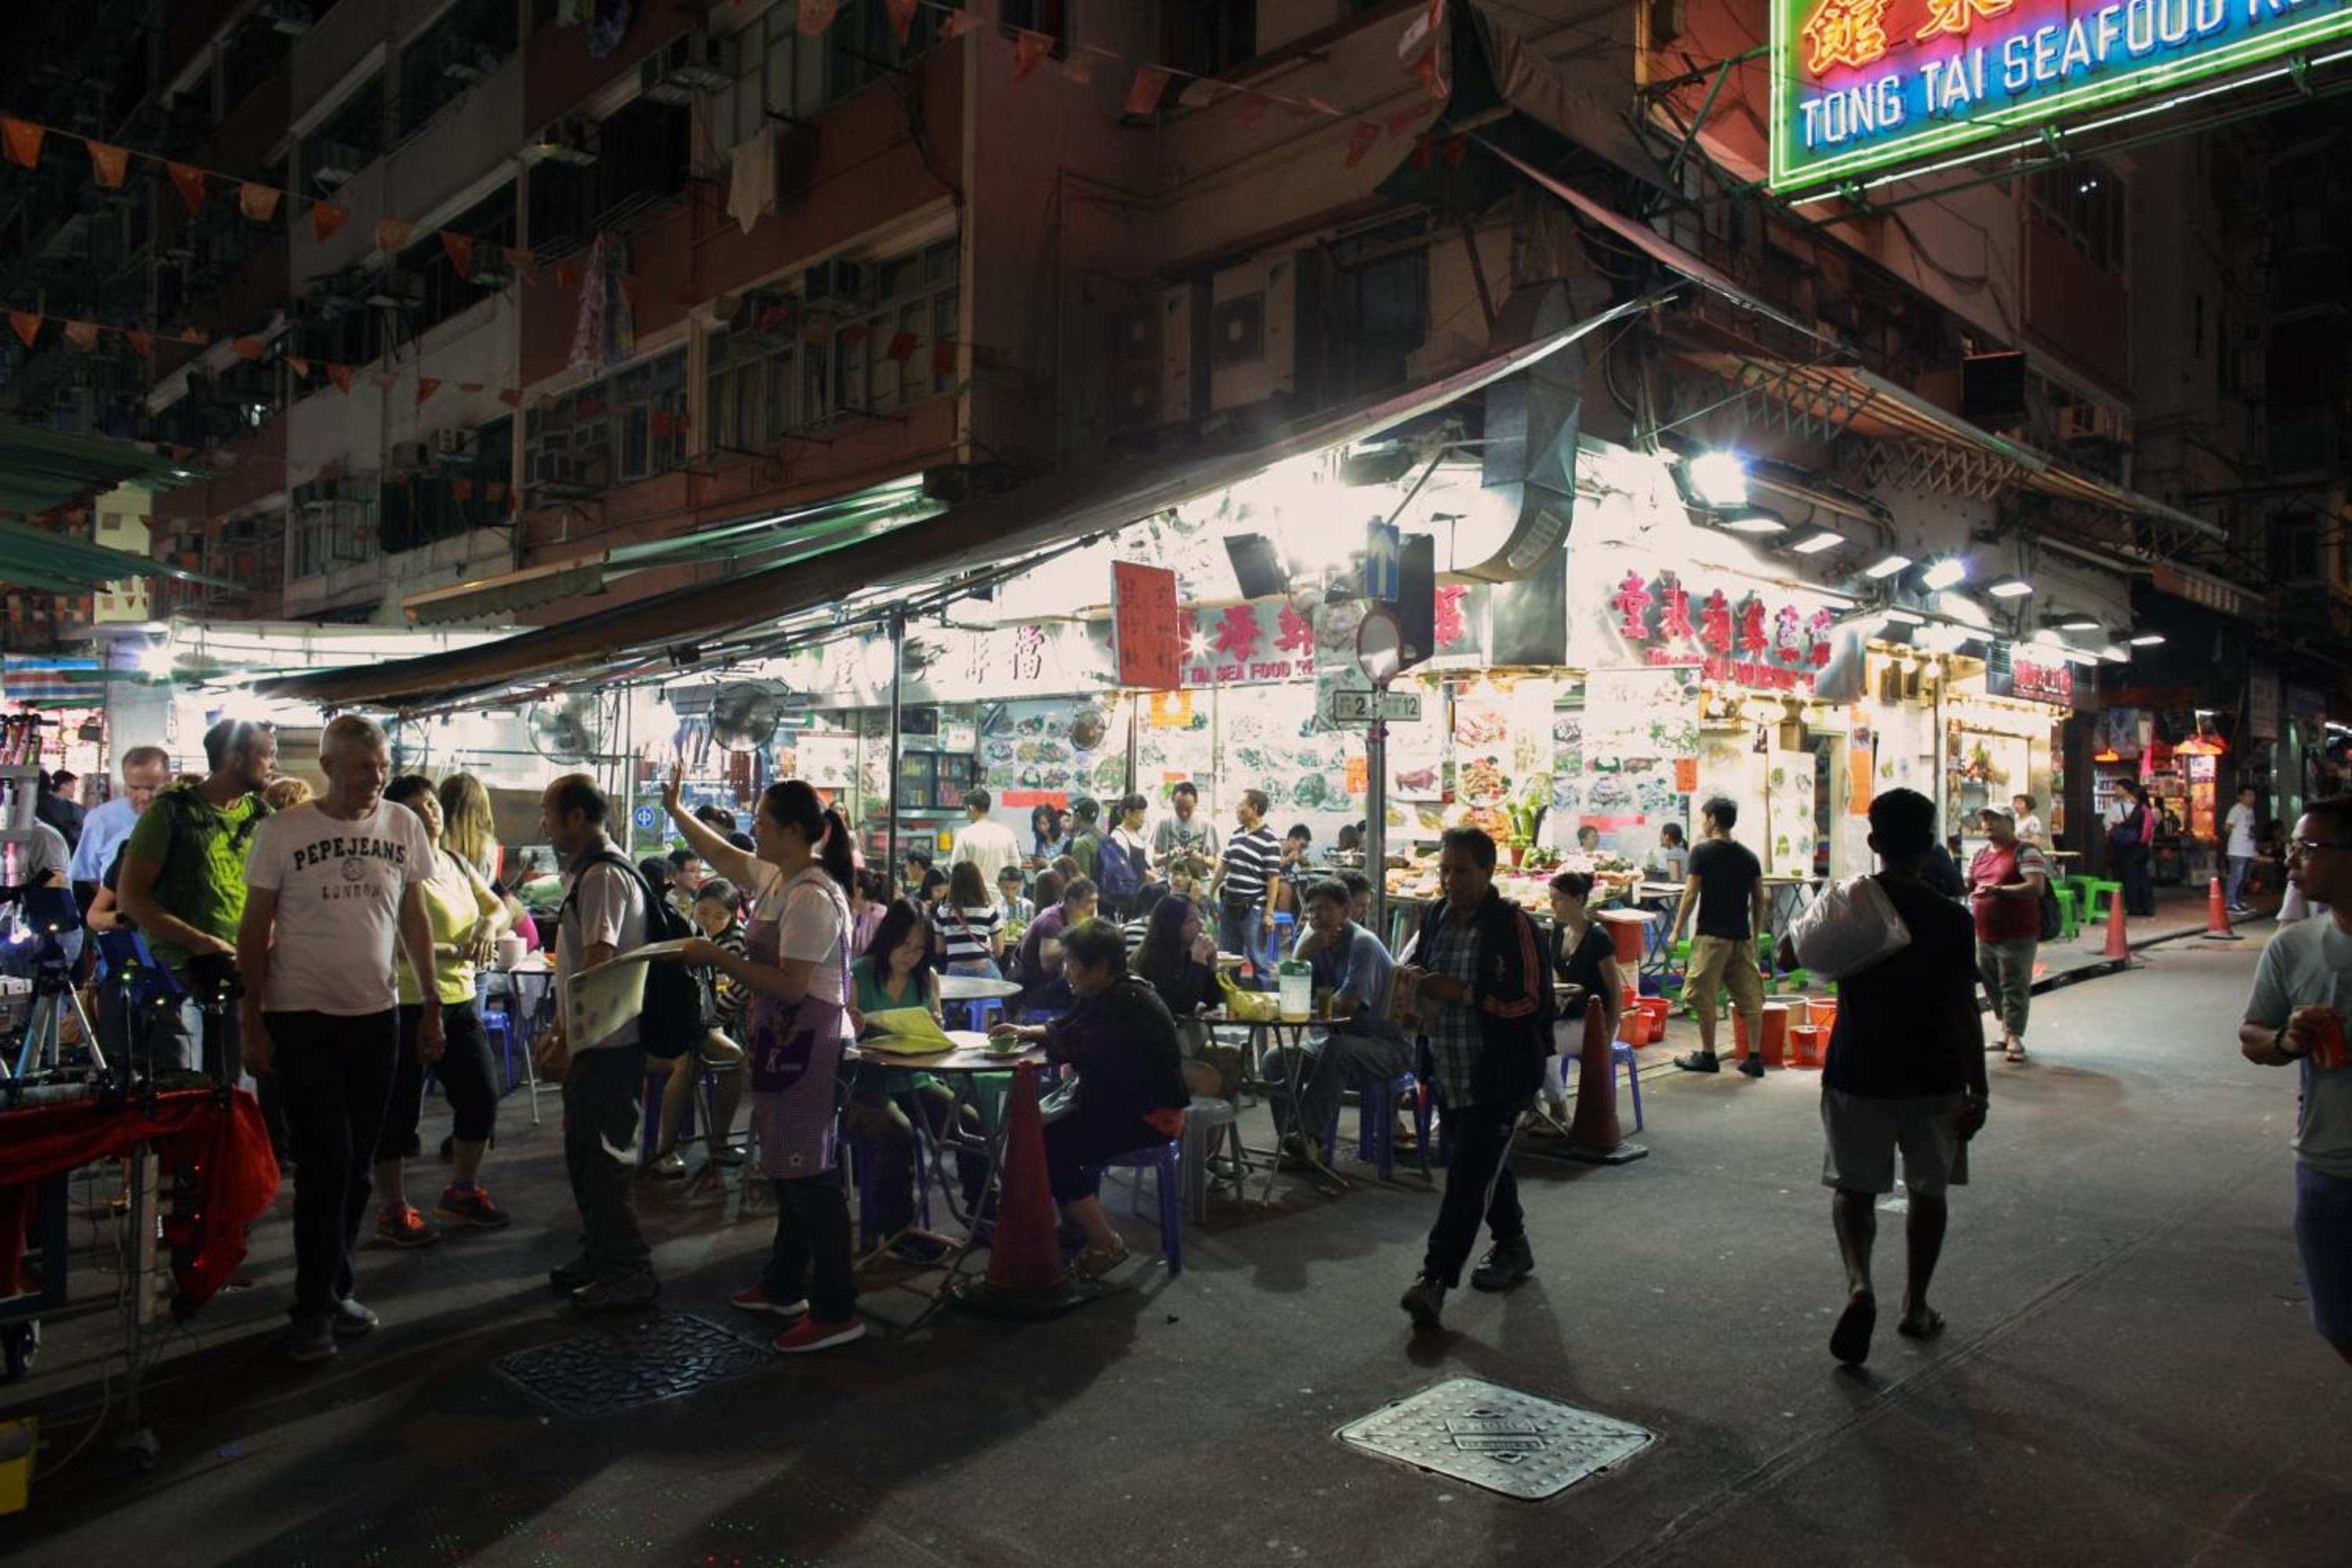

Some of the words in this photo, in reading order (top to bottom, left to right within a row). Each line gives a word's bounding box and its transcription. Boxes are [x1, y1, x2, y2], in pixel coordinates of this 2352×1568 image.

[1800, 74, 1901, 148] TONG
[1920, 47, 1984, 113] TAI
[2003, 0, 2227, 89] SEAFOOD
[1217, 663, 1245, 682] SEA
[1250, 661, 1291, 680] FOOD
[1355, 697, 1366, 715] 2
[294, 837, 346, 871] PEPE
[347, 837, 405, 864] JEANS
[322, 884, 381, 900] LONDON
